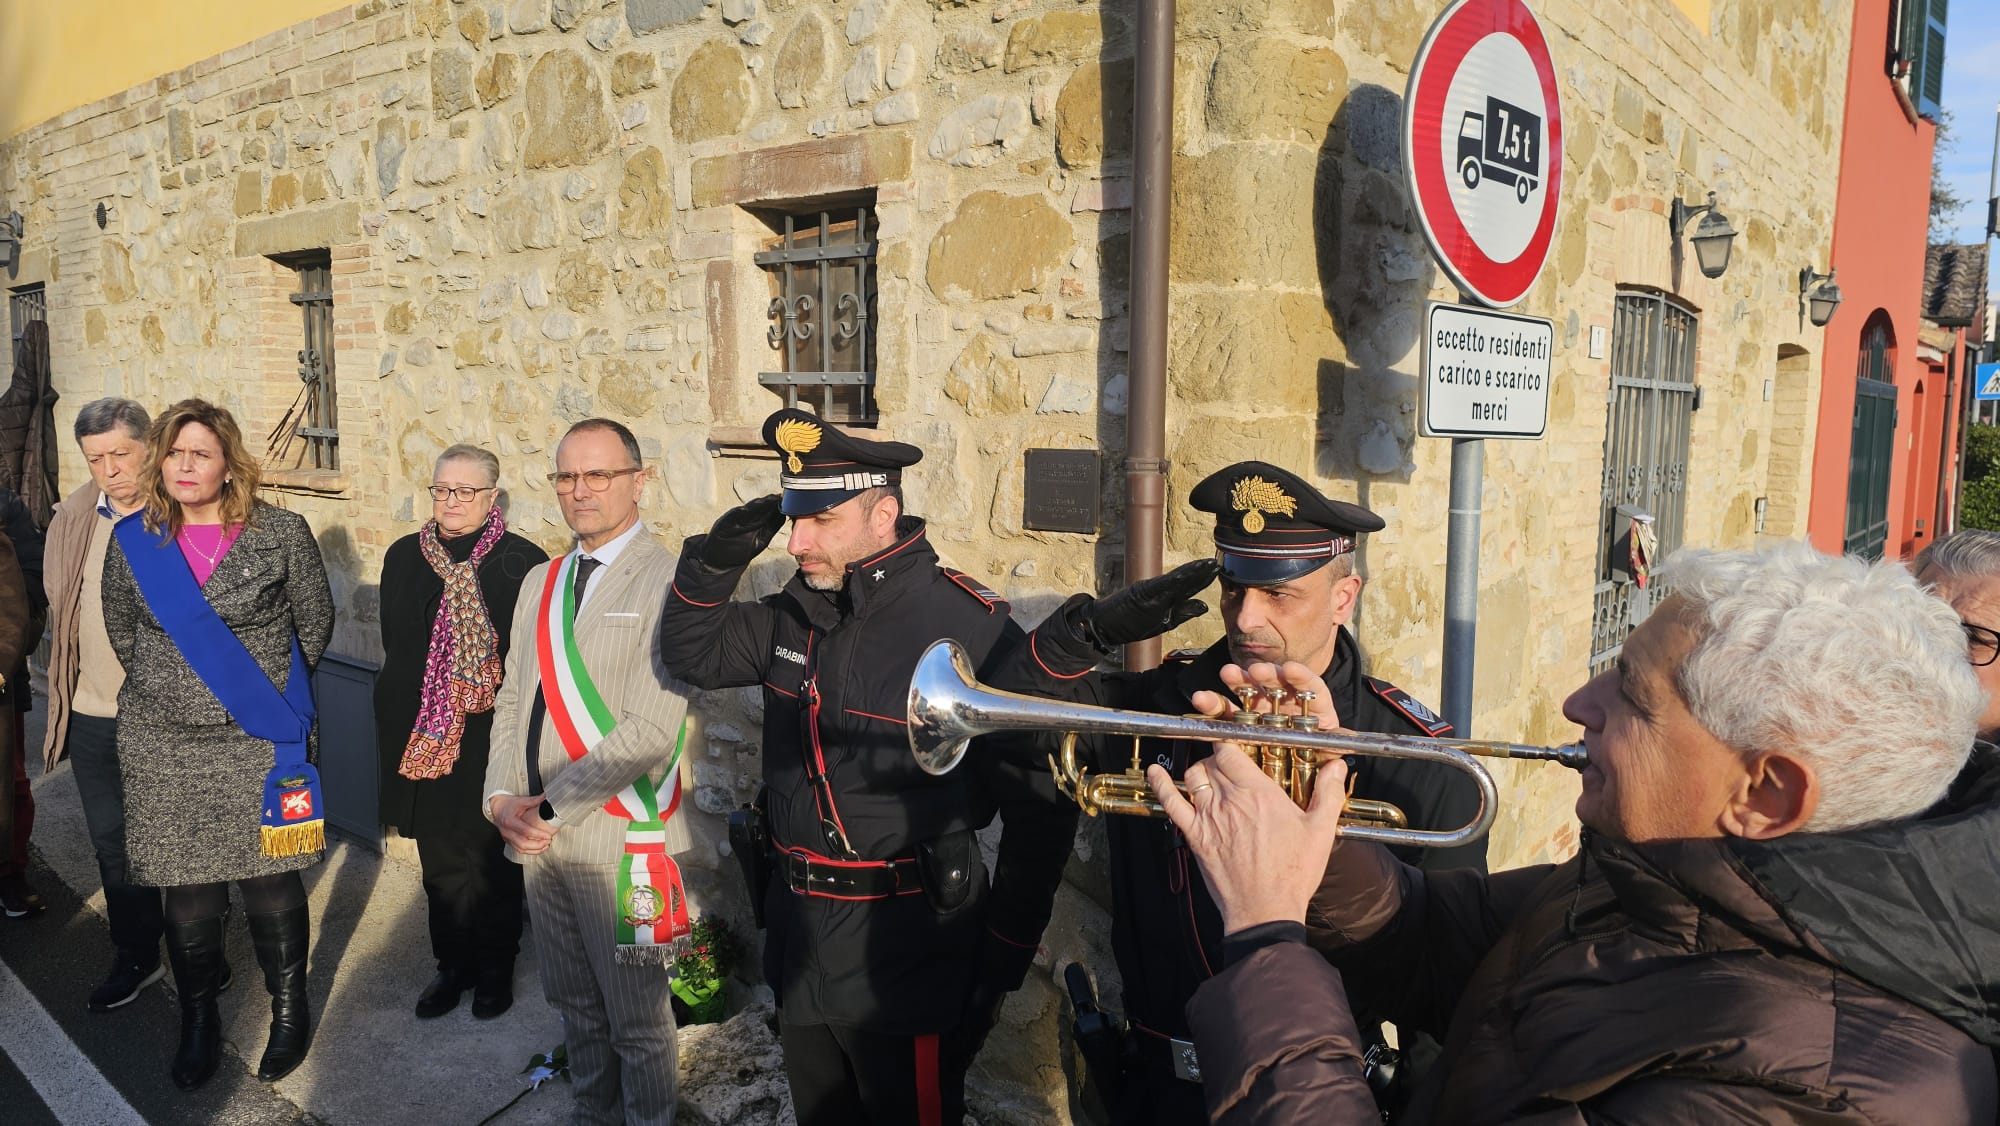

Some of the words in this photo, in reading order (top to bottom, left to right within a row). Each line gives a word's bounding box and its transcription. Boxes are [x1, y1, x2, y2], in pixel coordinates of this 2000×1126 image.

[1498, 108, 1520, 160] 7,5
[1524, 129, 1531, 163] t
[1437, 326, 1485, 353] eccetto
[1489, 331, 1547, 360] residenti
[1439, 360, 1481, 386] carico
[1485, 369, 1492, 388] e
[1495, 365, 1541, 391] scarico
[1471, 396, 1508, 421] merci
